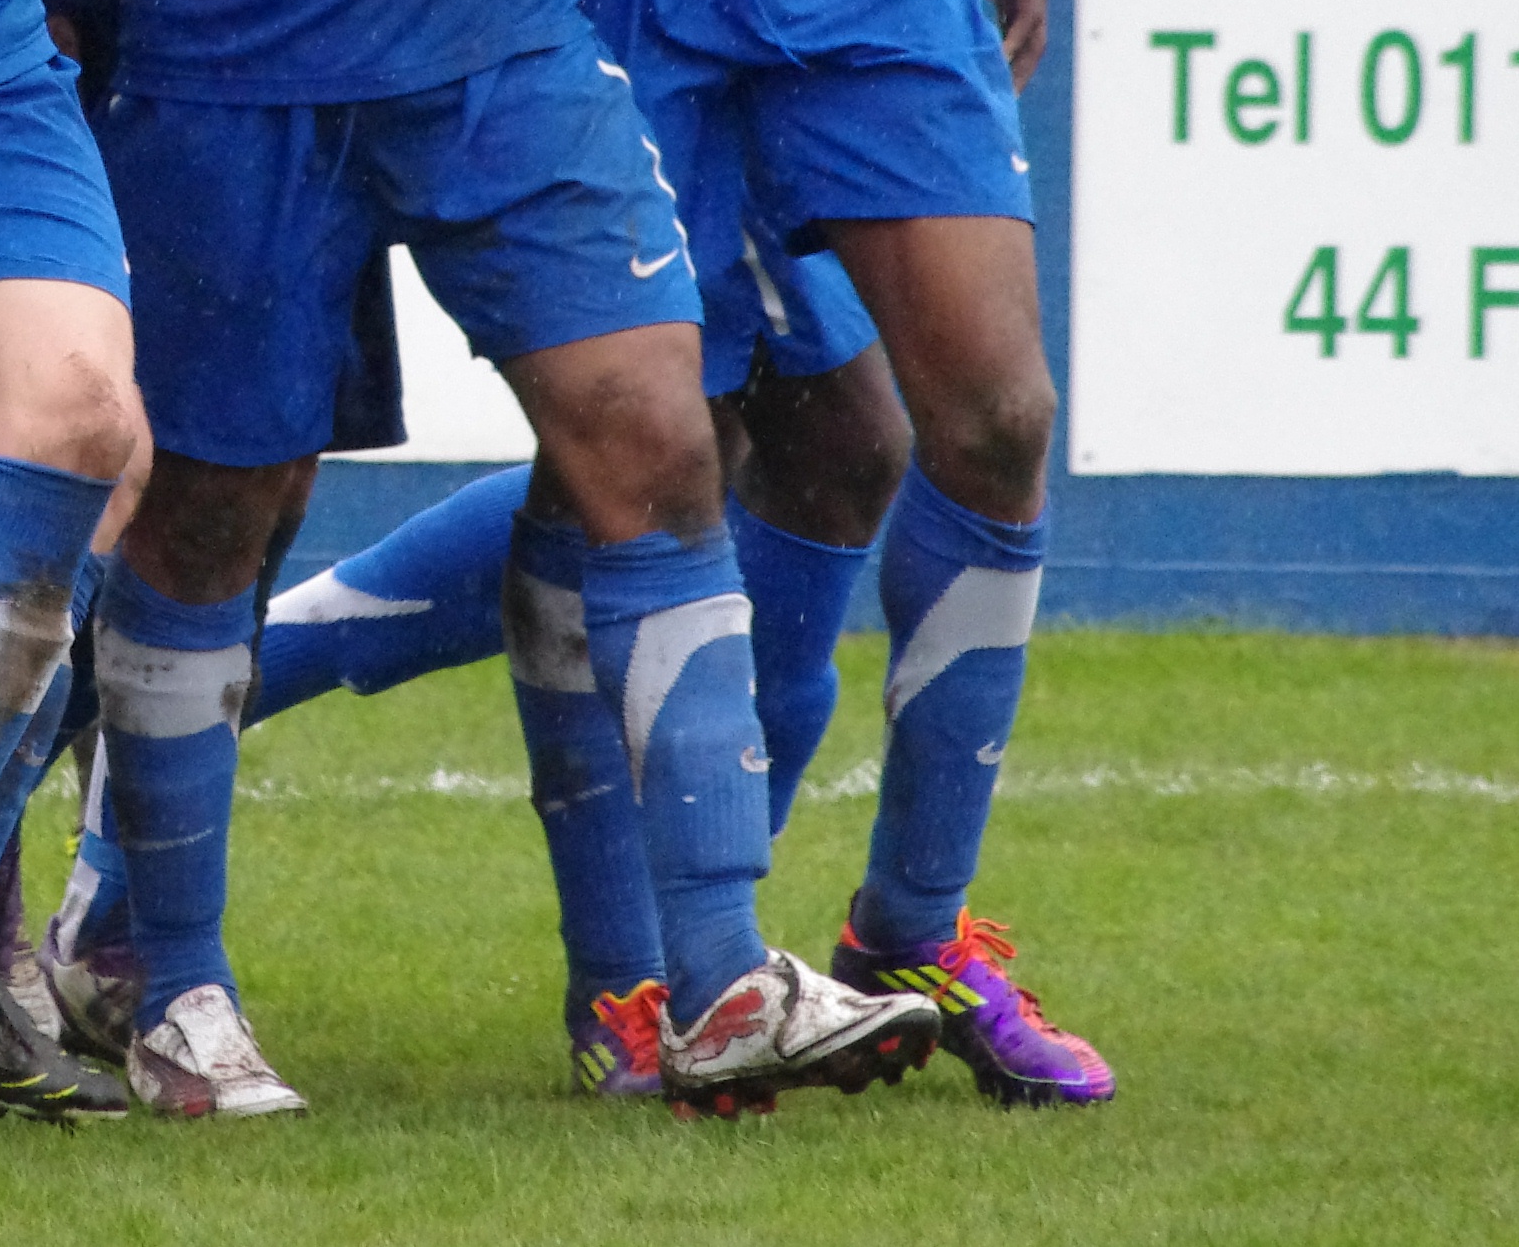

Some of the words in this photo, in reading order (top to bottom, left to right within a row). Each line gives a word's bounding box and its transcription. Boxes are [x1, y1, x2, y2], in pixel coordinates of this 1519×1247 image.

[1148, 31, 1311, 145] Tel
[1359, 29, 1519, 146] 01
[1282, 245, 1421, 360] 44
